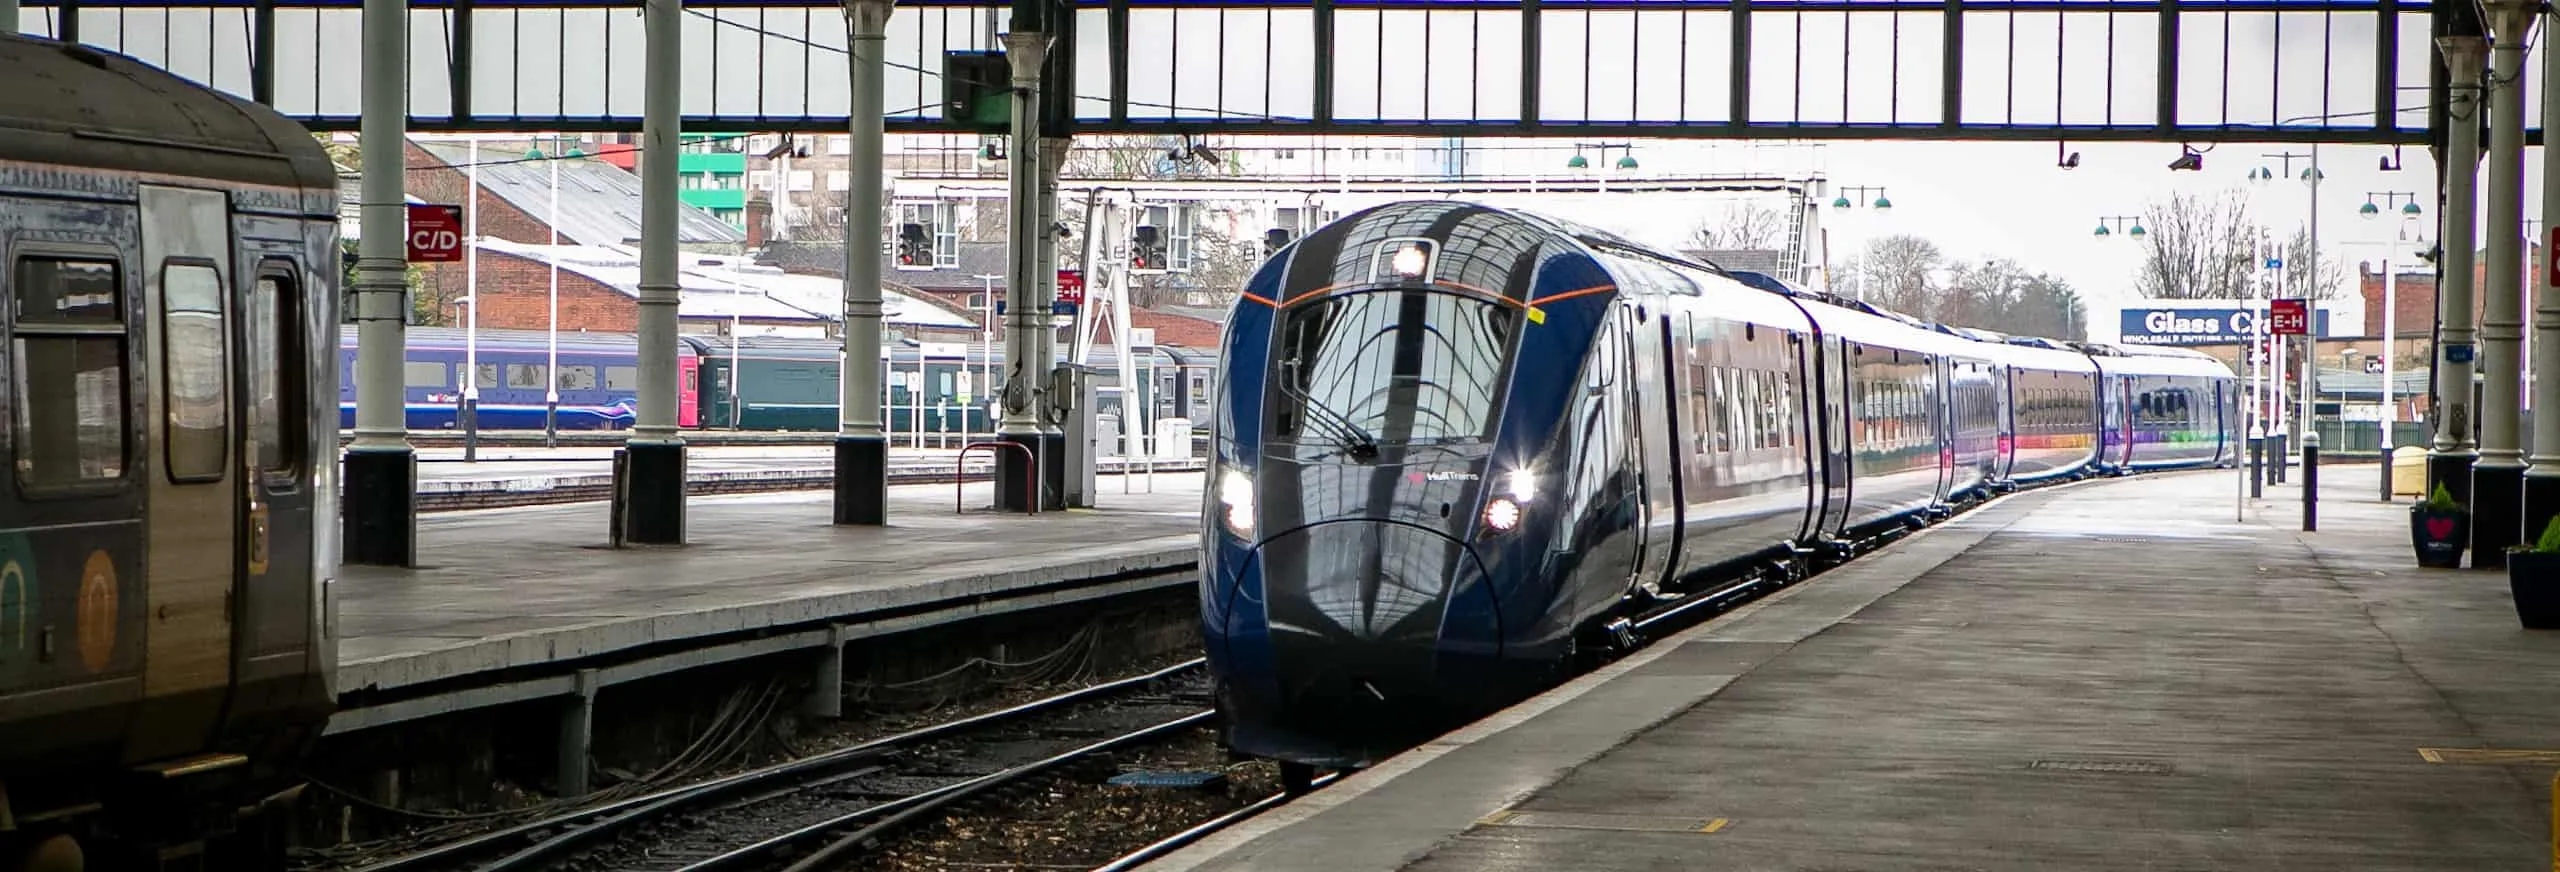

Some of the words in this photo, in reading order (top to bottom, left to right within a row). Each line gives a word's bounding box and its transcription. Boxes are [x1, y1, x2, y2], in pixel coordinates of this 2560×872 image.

[413, 230, 457, 250] C/D
[2145, 311, 2219, 334] Glass
[2274, 314, 2304, 328] E-H
